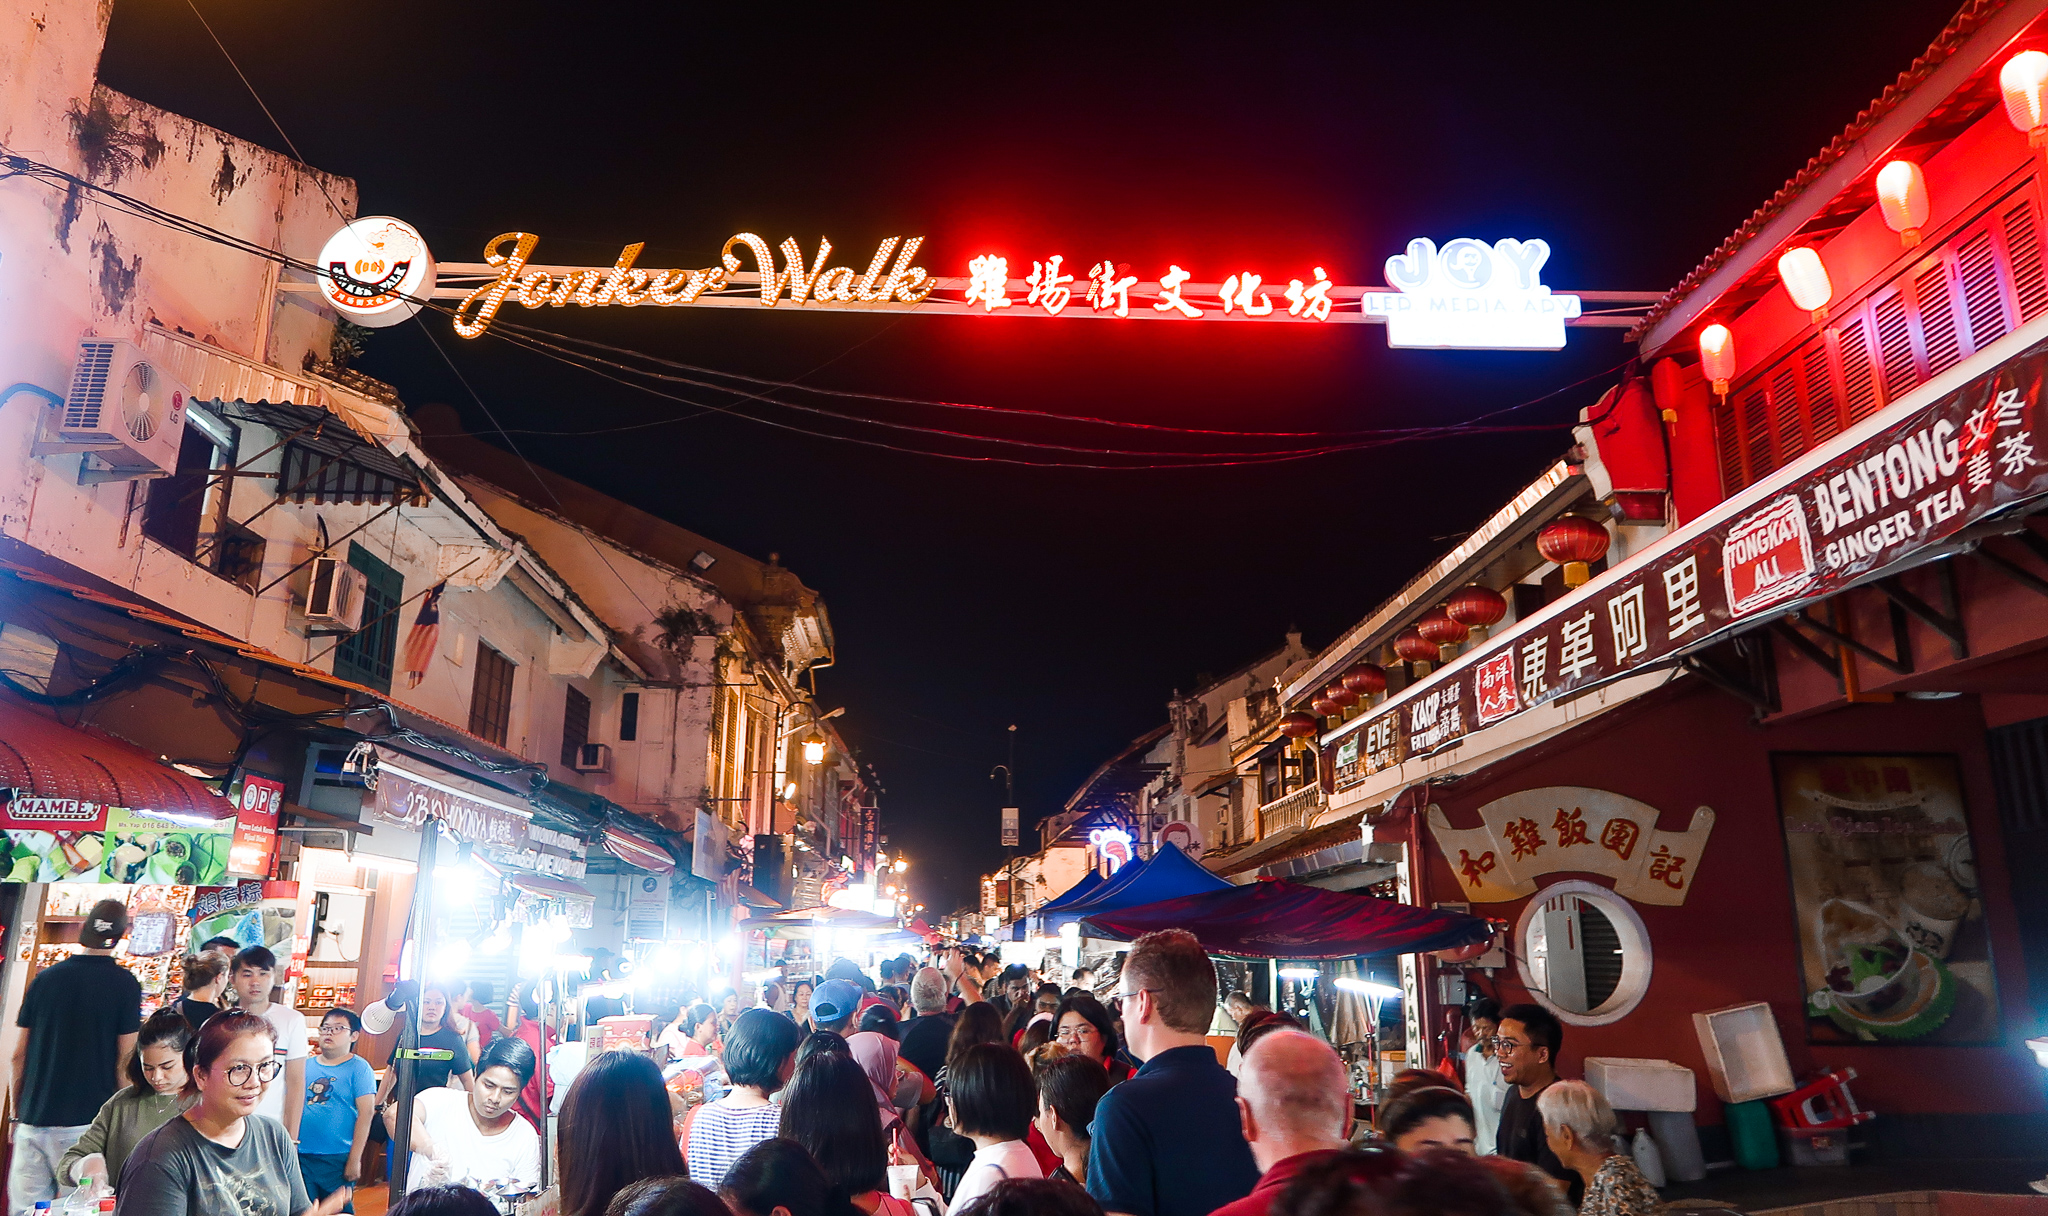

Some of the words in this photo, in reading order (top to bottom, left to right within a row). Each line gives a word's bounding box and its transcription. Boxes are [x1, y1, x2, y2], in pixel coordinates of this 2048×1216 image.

[453, 231, 726, 339] Jonker
[722, 231, 936, 307] Walk
[1387, 238, 1549, 291] JOY
[169, 410, 179, 425] LG
[1965, 388, 2026, 449] 文冬
[1814, 418, 1959, 535] BENTONG
[1967, 431, 2037, 493] 姜茶
[1728, 513, 1799, 569] TONGKAT
[1825, 509, 1915, 569] GINGER
[1916, 484, 1966, 531] TEA
[1521, 554, 1706, 701] 東革阿里
[1482, 659, 1510, 689] 南洋
[1366, 718, 1391, 754] EYE
[20, 800, 88, 813] MAMEE
[198, 882, 263, 916] 娘惹粽
